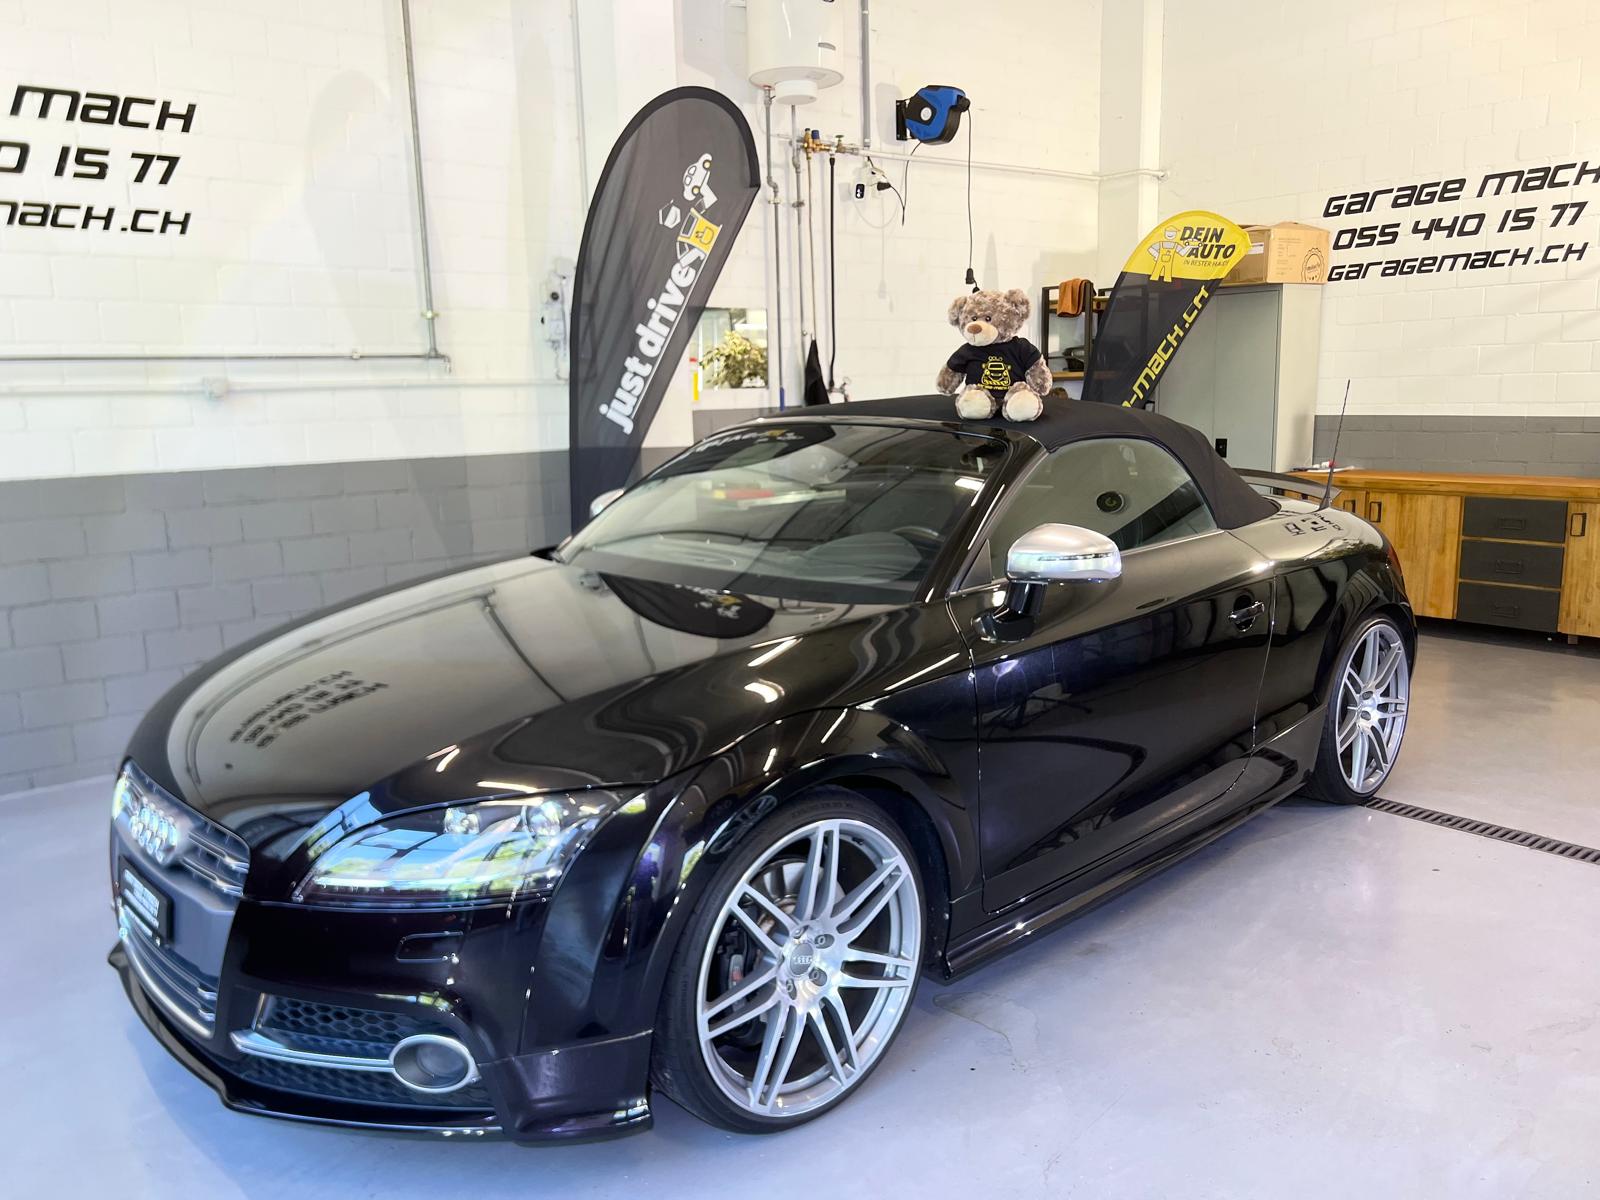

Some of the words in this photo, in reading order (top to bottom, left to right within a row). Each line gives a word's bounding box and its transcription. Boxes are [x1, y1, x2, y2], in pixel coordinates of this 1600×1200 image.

[54, 146, 110, 180] 15
[131, 153, 181, 185] 77
[1180, 226, 1225, 243] DEIN
[1332, 223, 1401, 250] 055
[1411, 213, 1486, 240] 440
[1497, 206, 1538, 233] 15
[1549, 201, 1589, 228] 77
[1186, 244, 1236, 259] AUTO
[599, 356, 653, 435] just
[635, 262, 697, 358] drive
